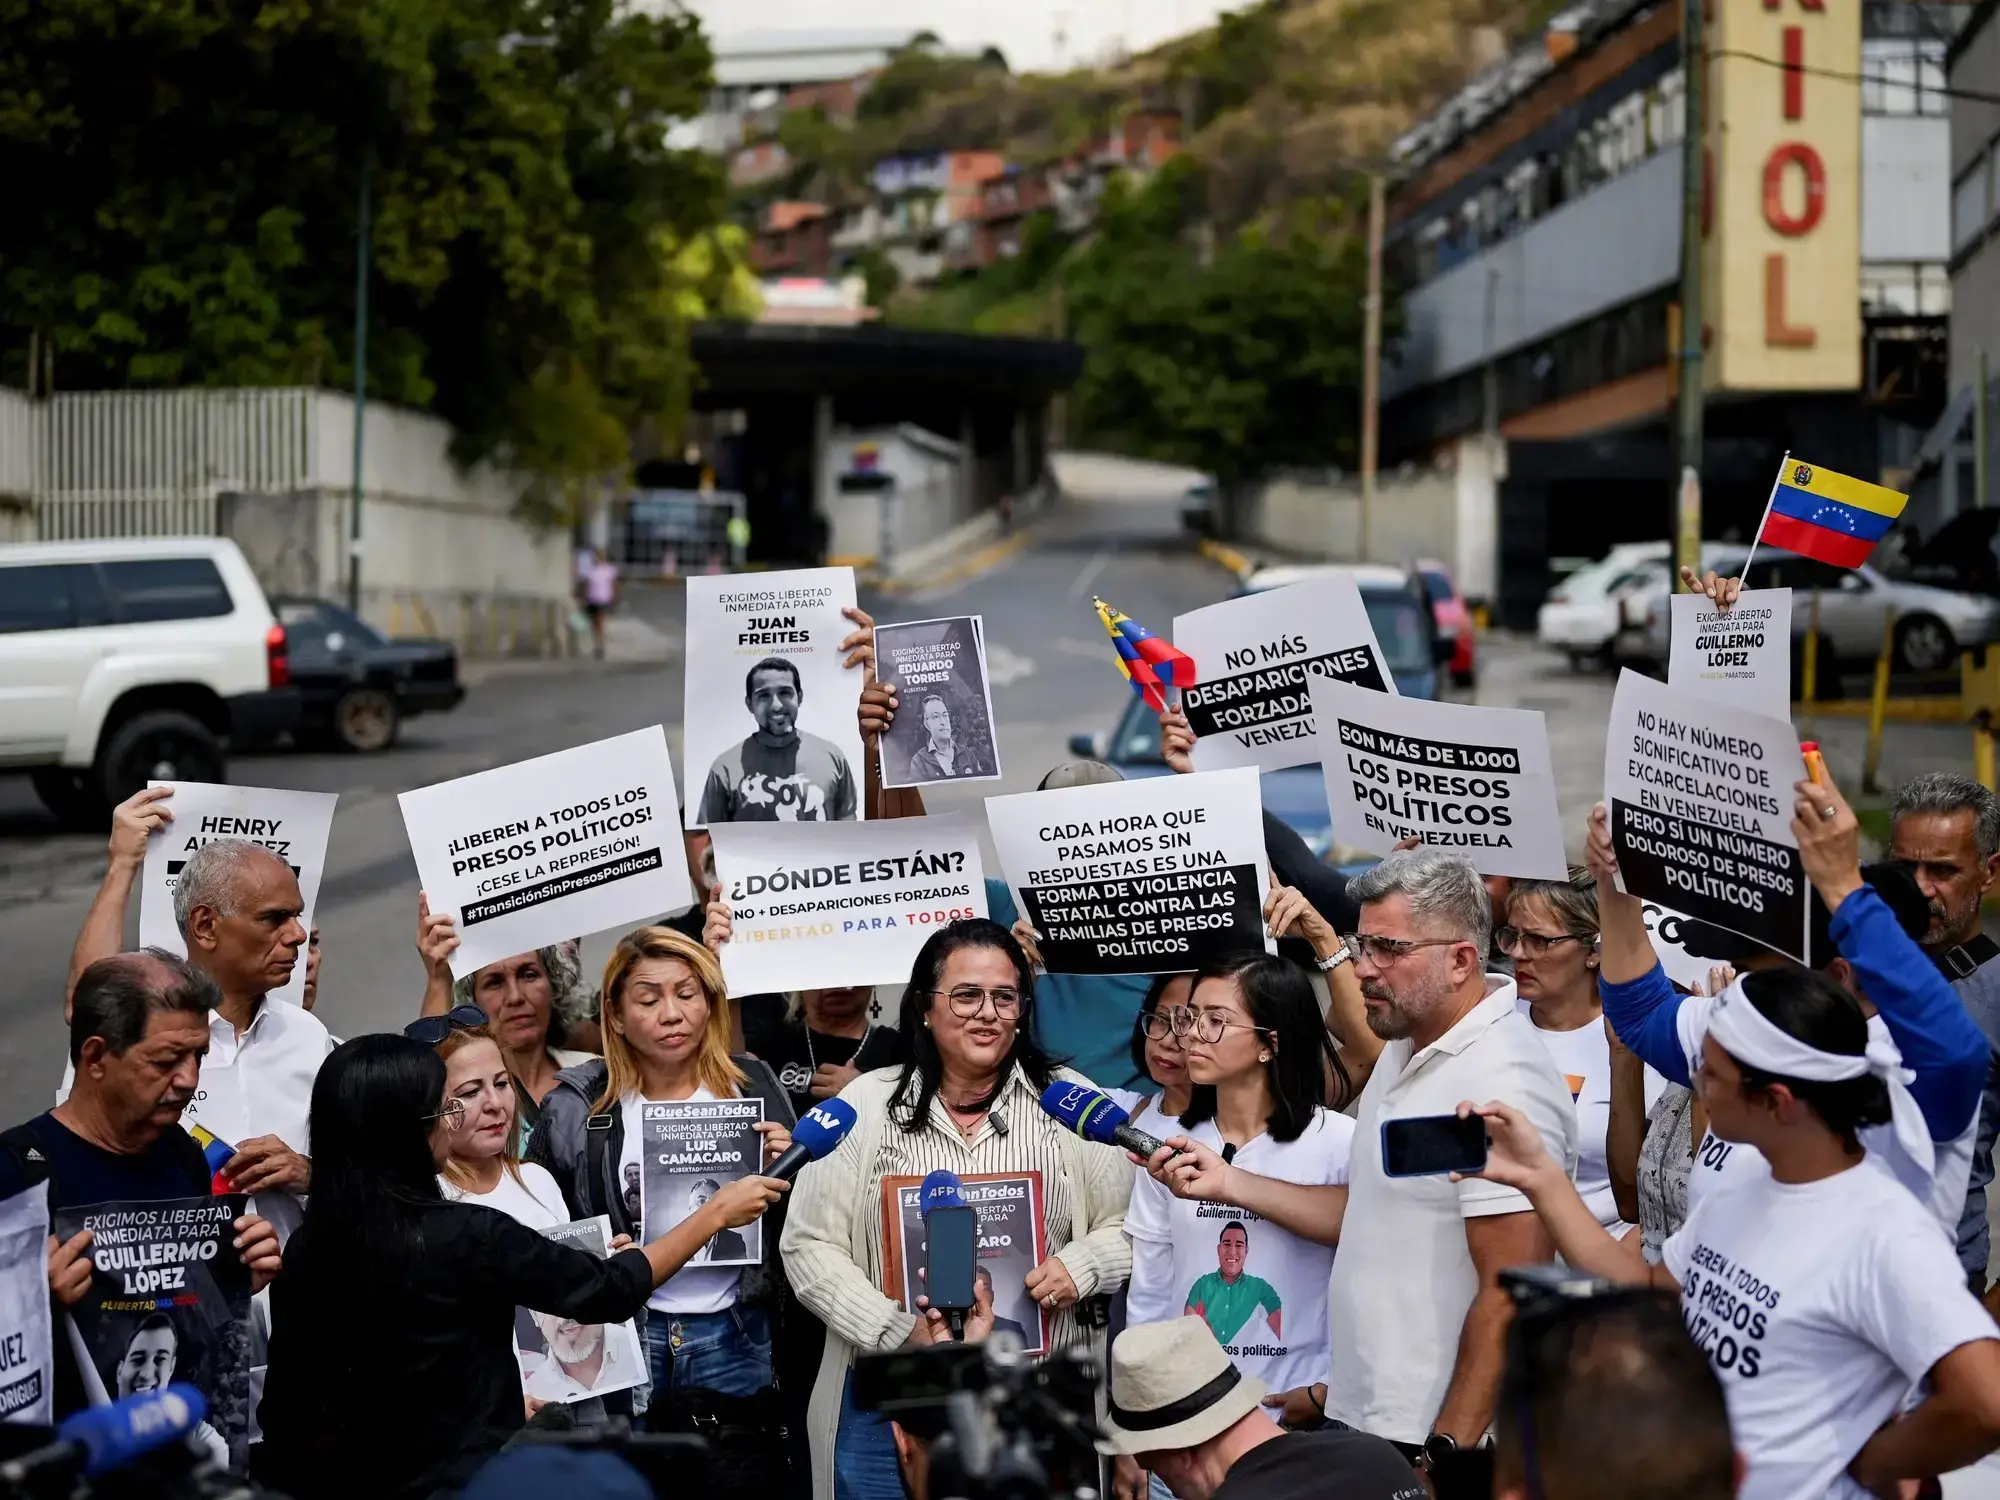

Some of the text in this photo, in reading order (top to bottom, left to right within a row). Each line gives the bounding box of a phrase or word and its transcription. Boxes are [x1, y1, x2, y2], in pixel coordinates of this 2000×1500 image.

[1762, 0, 1827, 350] IOL
[719, 587, 832, 603] EXIGIMOS LIBERTAD
[725, 598, 825, 613] INMEDIATA PARA
[747, 616, 796, 631] JUAN
[1696, 609, 1772, 623] EXIGIMOS LIBERTAD
[1699, 621, 1765, 634] INMEDIATA PARA
[738, 630, 810, 645] FREITES
[892, 642, 961, 657] EXIGIMOS LIBERTAD
[1225, 634, 1308, 670] NO MÁS
[1695, 633, 1765, 650] GUILLERMO
[896, 650, 956, 664] INMEDIATA PARA
[898, 659, 954, 674] EDUARDO
[1708, 648, 1749, 667] LÓPEZ
[905, 672, 950, 685] TORRES
[1186, 650, 1369, 709] DESAPARICIONES
[1211, 692, 1311, 729] FORZADA
[1234, 717, 1317, 748] VENEZU
[1340, 725, 1516, 769] SON MÁS DE 1.000
[1637, 709, 1763, 761] NO HAY NÚMERO
[1347, 753, 1510, 799] LOS PRESOS
[1633, 735, 1770, 788] SIGNIFICATIVO DE
[1628, 759, 1779, 816] EXCARCELACIONES
[1352, 780, 1512, 827] POLÍTICOS
[1640, 789, 1763, 837] EN VENEZUELA
[200, 816, 282, 836] HENRY
[448, 786, 648, 856] ¡LIBEREN A TODOS LOS
[1039, 808, 1206, 842] CADA HORA QUE
[1364, 812, 1513, 849] EN VENEZUELA
[452, 806, 653, 877] PRESOS POLÍTICOS!
[1057, 832, 1191, 861] PASAMOS SIN
[1624, 808, 1791, 869] PERO SÍ UN NÚMERO
[476, 835, 641, 897] ¡CESE LA REPRESIÓN!
[730, 850, 965, 901] ¿DÓNDE ESTÁN?
[1028, 849, 1228, 885] RESPUESTAS ES UNA
[1625, 832, 1794, 896] DOLOROSO DE PRESOS
[467, 854, 658, 921] #TransiciónSinPresosPolíticos
[734, 884, 970, 921] NO + DESAPARICIONES FORZADAS
[1035, 870, 1237, 905] FORMA DE VIOLENCIA
[1664, 865, 1764, 913] POLÍTICOS
[1041, 891, 1236, 923] ESTATAL CONTRA LAS
[734, 907, 975, 944] LIBERTAD PARA TODOS
[1048, 912, 1235, 941] FAMILIAS DE PRESOS
[1097, 937, 1190, 958] POLÍTICOS
[644, 1104, 758, 1119] #QueSeanTodos
[656, 1122, 748, 1133] EXIGIMOS LIBERTAD
[661, 1130, 741, 1140] INMEDIATA PARA
[658, 1151, 742, 1165] CAMACARO
[685, 1140, 717, 1152] LUIS
[928, 1186, 955, 1199] AFP
[84, 1205, 232, 1231] EXIGIMOS LIBERTAD
[976, 1204, 1016, 1215] BERTAD
[981, 1213, 1009, 1223] PARA
[1196, 1206, 1241, 1220] Guillermo
[93, 1223, 220, 1247] INMEDIATA PARA
[94, 1240, 218, 1272] GUILLERMO
[123, 1265, 185, 1294] LÓPEZ
[1691, 1244, 1729, 1277] BEREN
[1734, 1268, 1780, 1309] TODOS
[101, 1294, 198, 1311] #LIBERTADPARA
[1682, 1268, 1767, 1340] OS PRESOS
[1243, 1344, 1287, 1358] políticos
